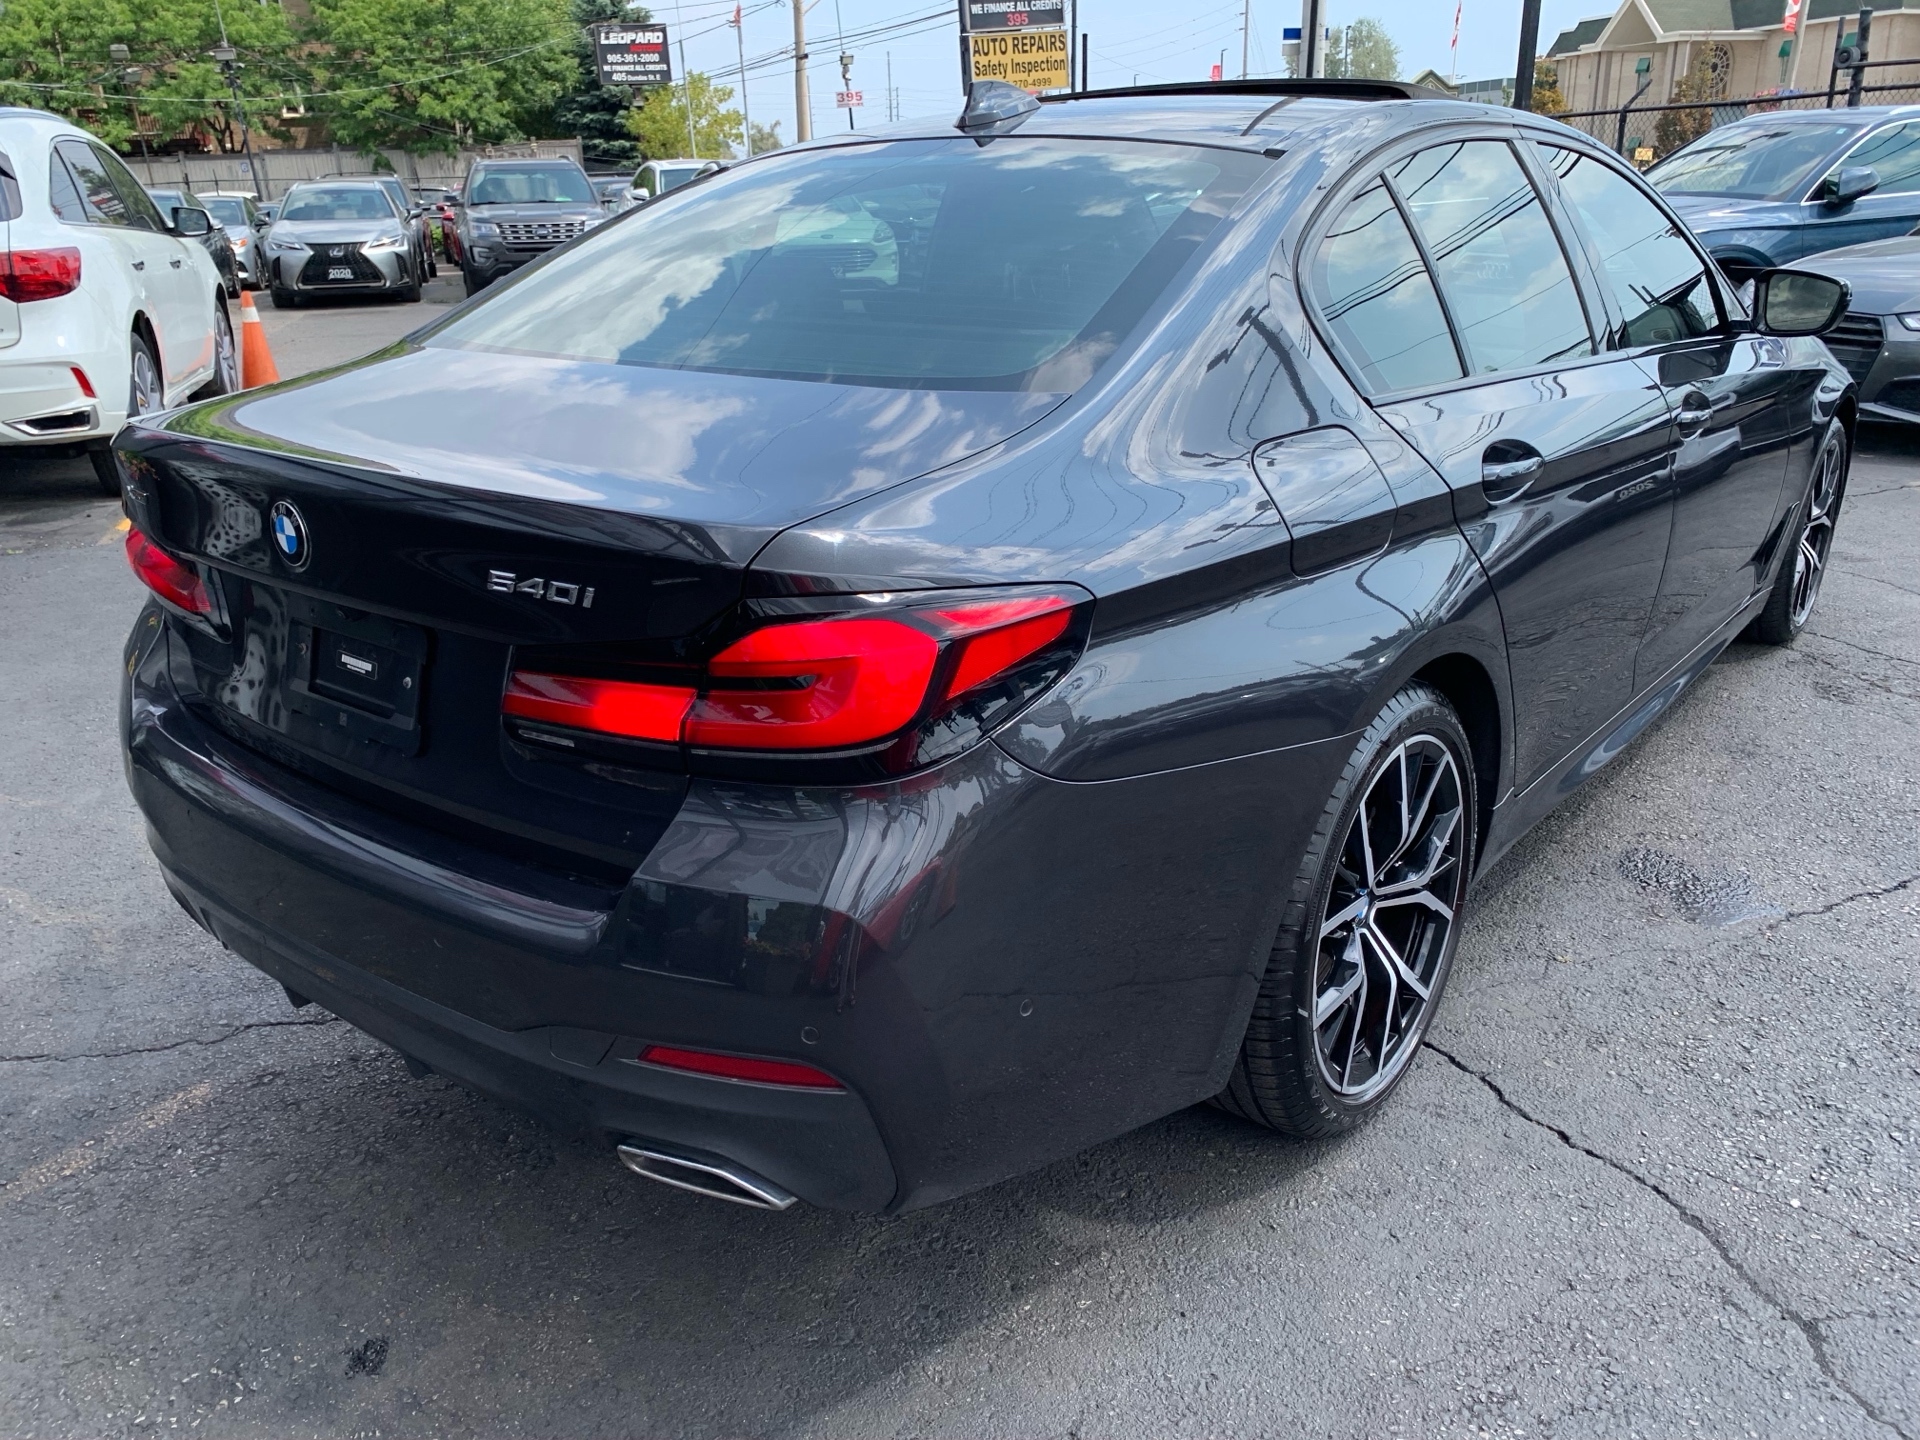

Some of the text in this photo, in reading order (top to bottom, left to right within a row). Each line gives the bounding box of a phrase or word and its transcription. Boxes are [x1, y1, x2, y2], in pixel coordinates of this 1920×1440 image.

[970, 0, 1062, 14] WE FINANCE ALL CREDITS
[1007, 13, 1029, 26] 395
[601, 32, 664, 44] LEOPARD
[973, 34, 1066, 57] AUTO REPAIRS
[606, 53, 659, 63] 905-361-2000
[974, 56, 1066, 79] Safety Inspection
[612, 73, 627, 81] 405
[837, 91, 863, 102] 395
[328, 268, 352, 278] 2020
[487, 569, 595, 608] 540i
